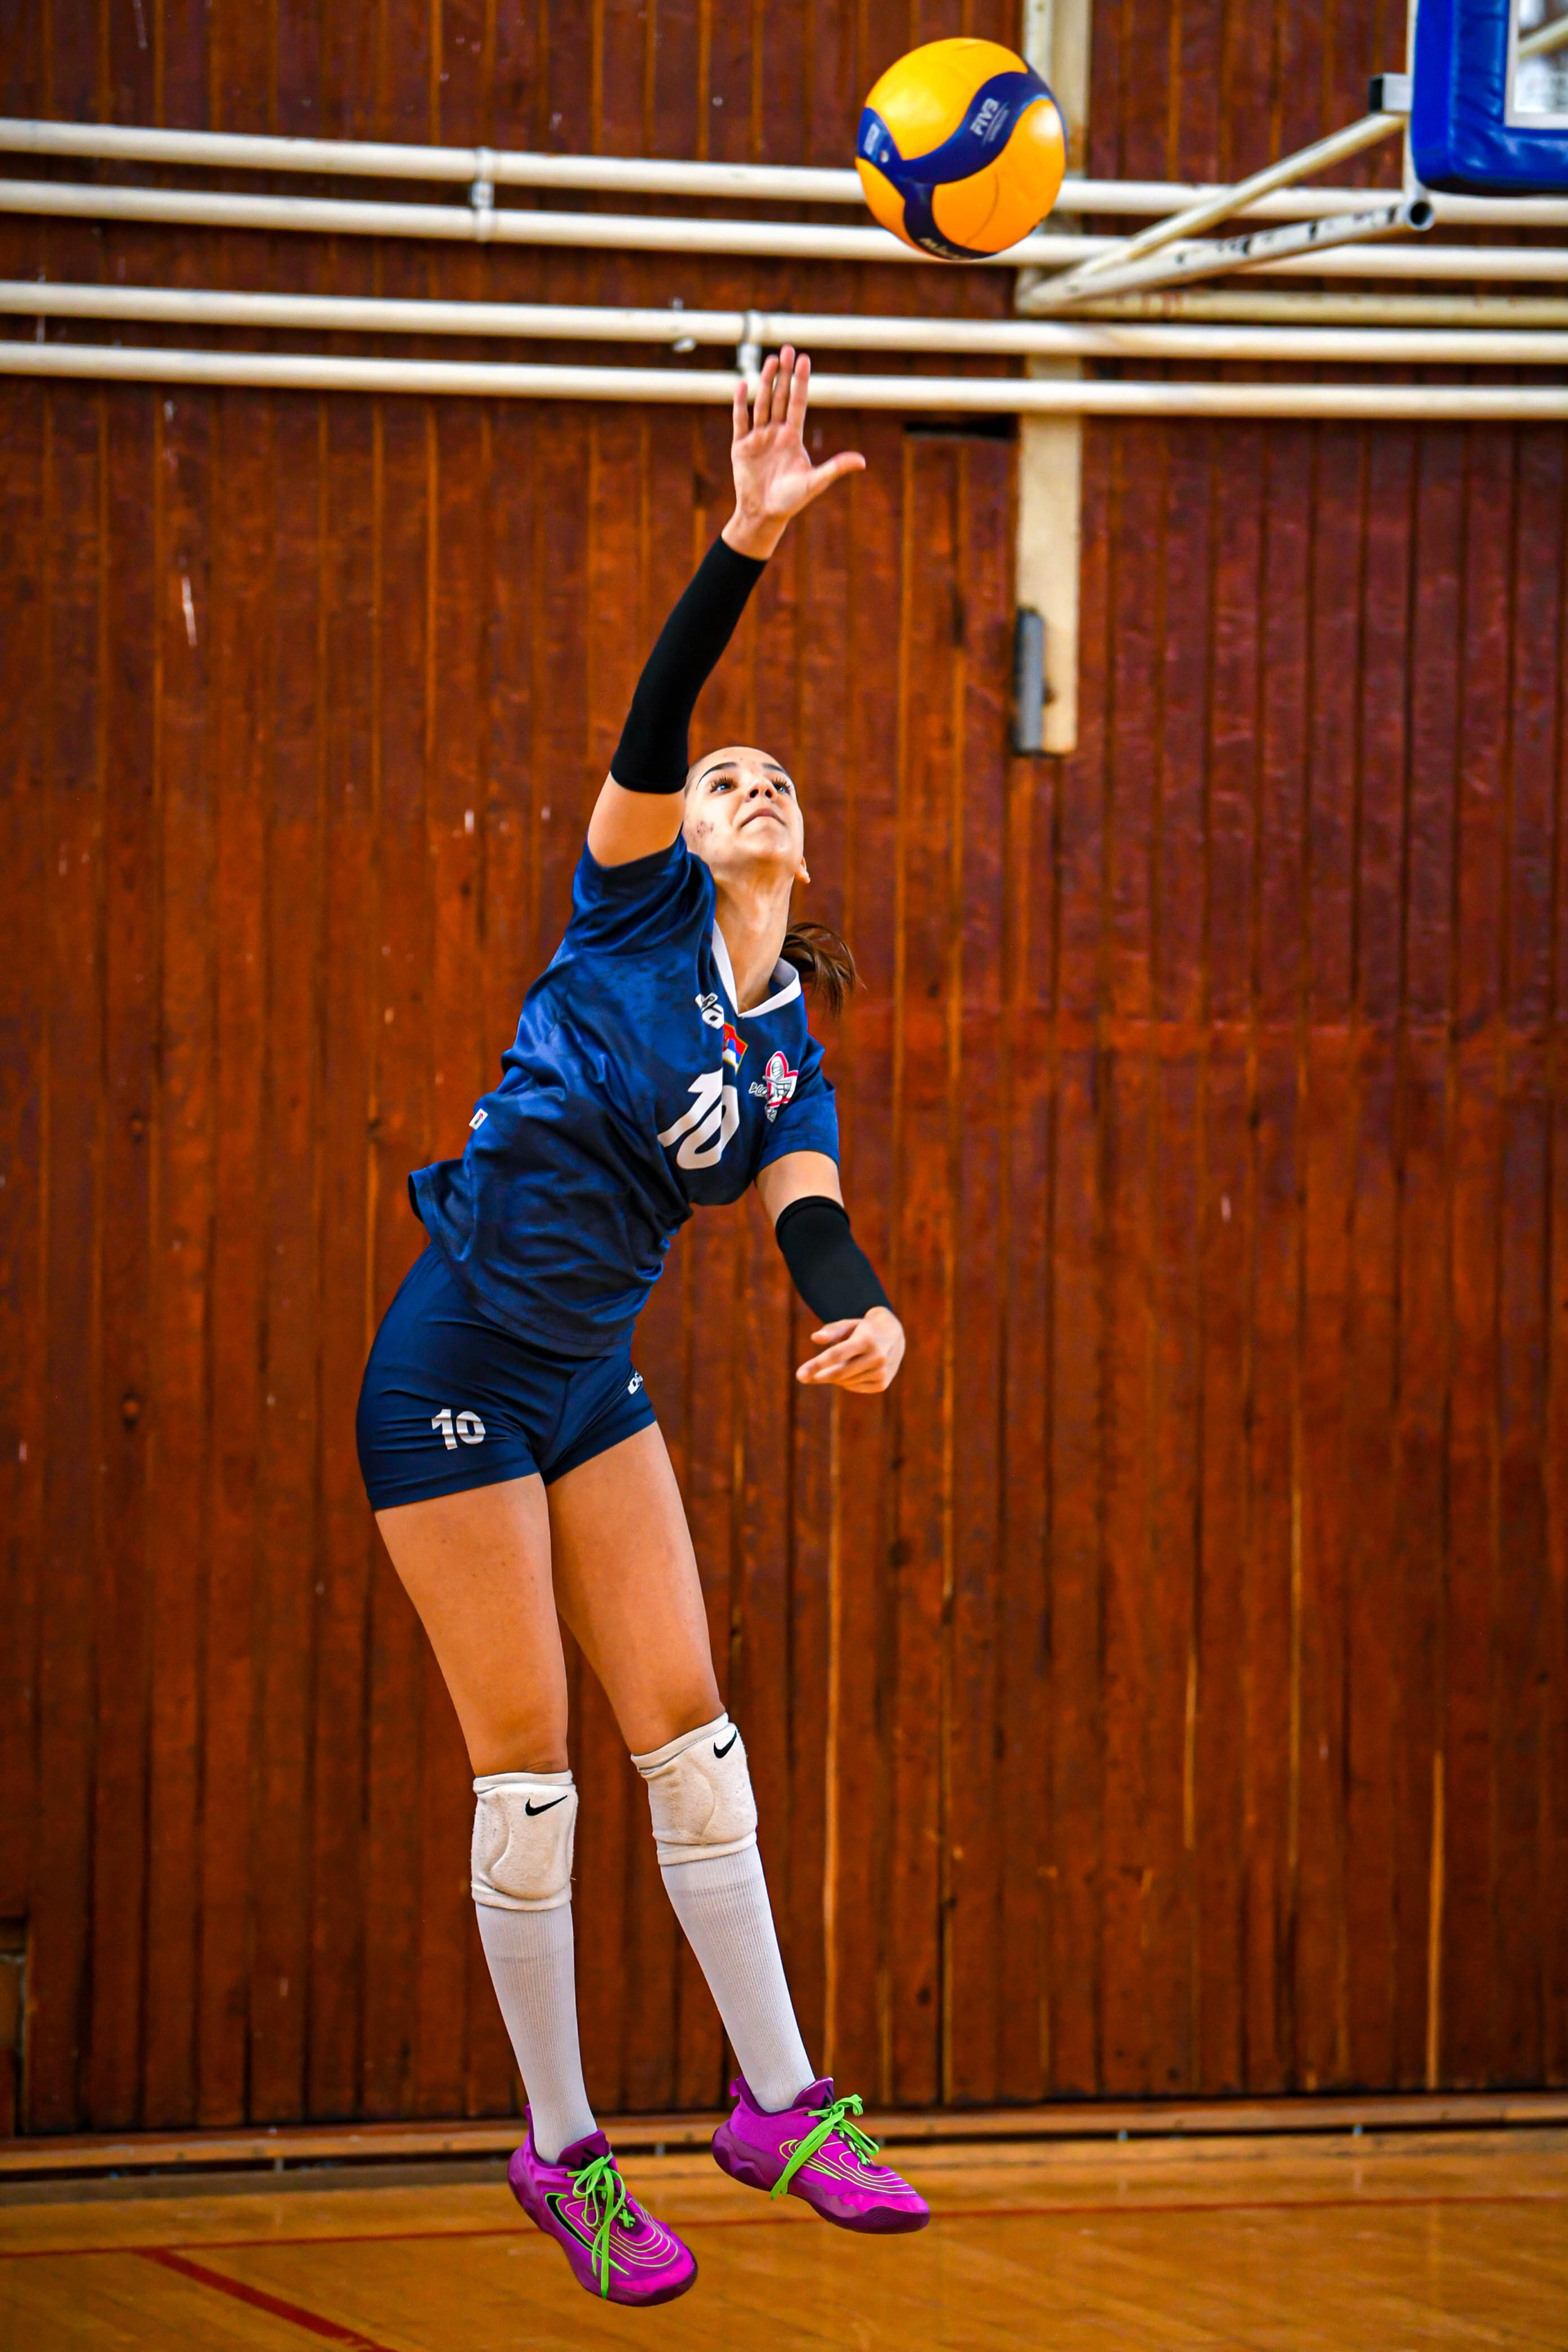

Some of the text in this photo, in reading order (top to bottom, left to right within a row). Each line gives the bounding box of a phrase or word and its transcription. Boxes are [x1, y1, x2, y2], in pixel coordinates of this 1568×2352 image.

[970, 98, 1000, 136] FIVB
[657, 1068, 740, 1169] 10
[431, 1409, 486, 1450] 10
